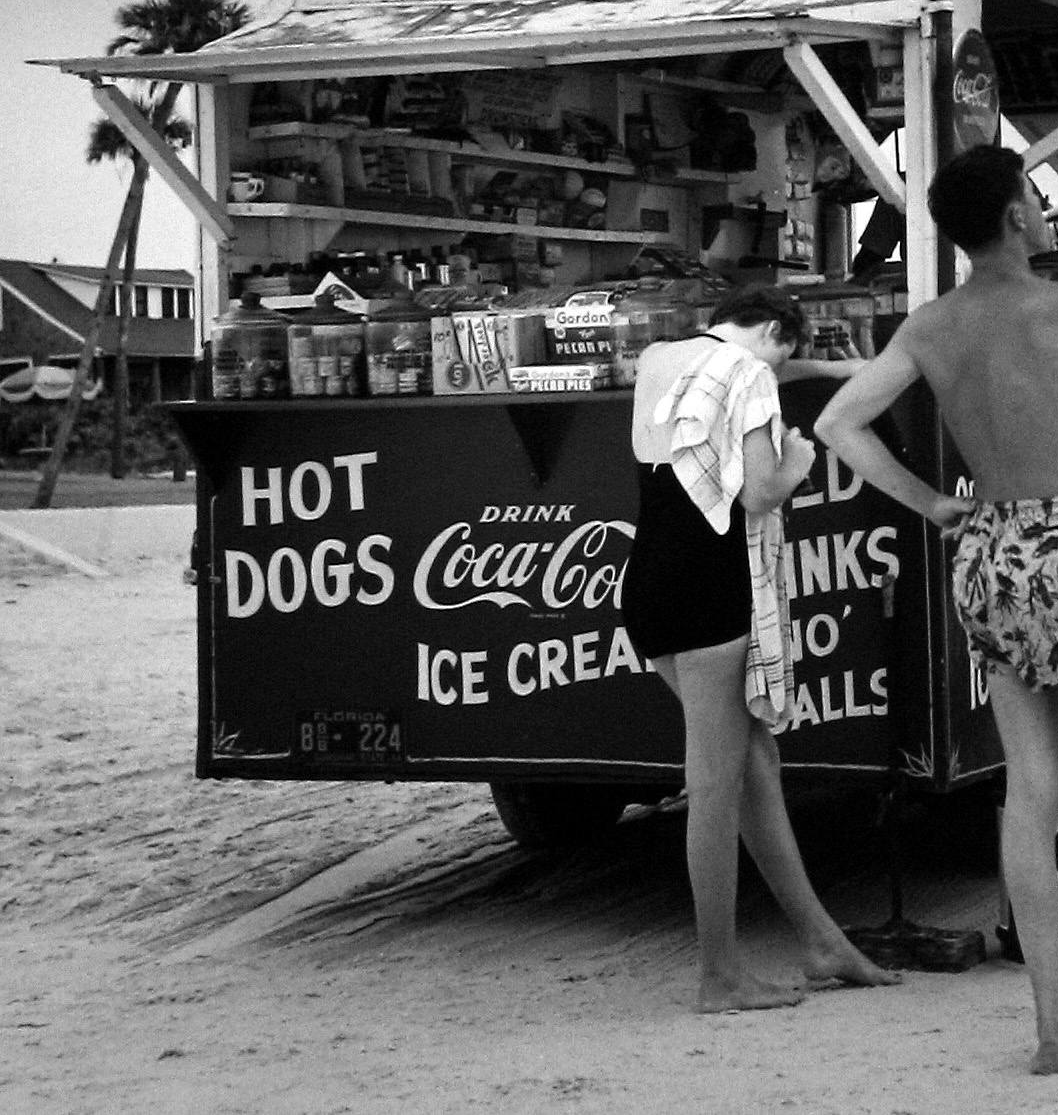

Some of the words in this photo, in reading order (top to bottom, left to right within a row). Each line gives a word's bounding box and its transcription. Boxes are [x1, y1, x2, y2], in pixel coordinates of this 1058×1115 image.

[556, 342, 596, 354] PECAN
[598, 340, 612, 353] PI
[241, 451, 378, 526] HOT
[479, 504, 577, 524] DRINK
[225, 534, 395, 618] DOGS
[413, 520, 637, 610] Coca-Col
[784, 526, 900, 600] INKS
[417, 642, 490, 705] ICE
[507, 626, 657, 697] CREA
[784, 667, 889, 734] ALLS
[313, 711, 386, 722] FLORIDA
